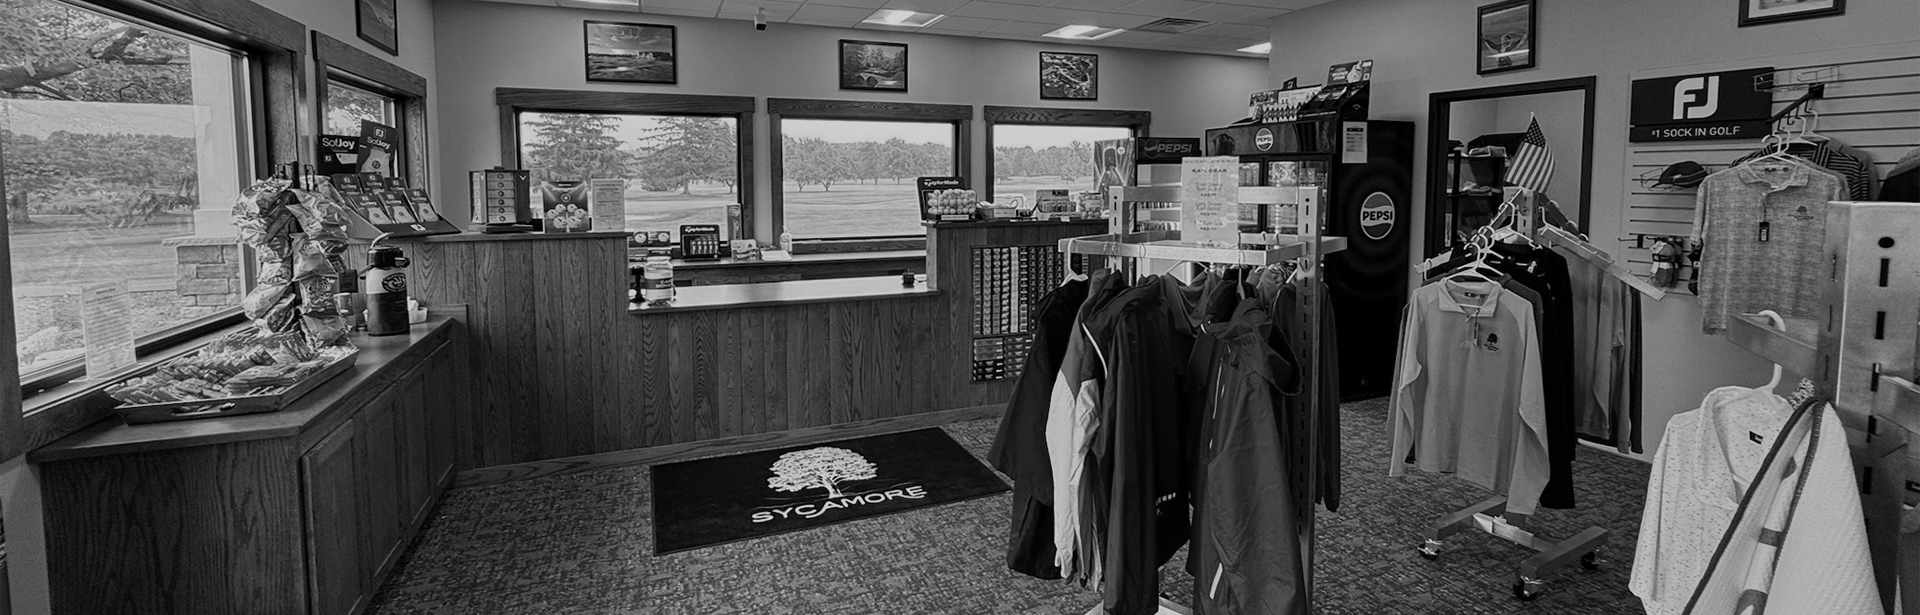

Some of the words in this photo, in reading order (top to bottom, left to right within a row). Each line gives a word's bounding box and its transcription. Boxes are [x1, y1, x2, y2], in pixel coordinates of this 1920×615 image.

[1672, 75, 1720, 120] FJ
[1652, 129, 1660, 138] #1
[1663, 128, 1692, 137] SOCK
[1695, 127, 1706, 136] IN
[1709, 125, 1740, 136] GOLF
[1157, 144, 1192, 153] PEPSI
[1363, 210, 1393, 221] PEPSI
[752, 485, 928, 523] SYCAMORE
